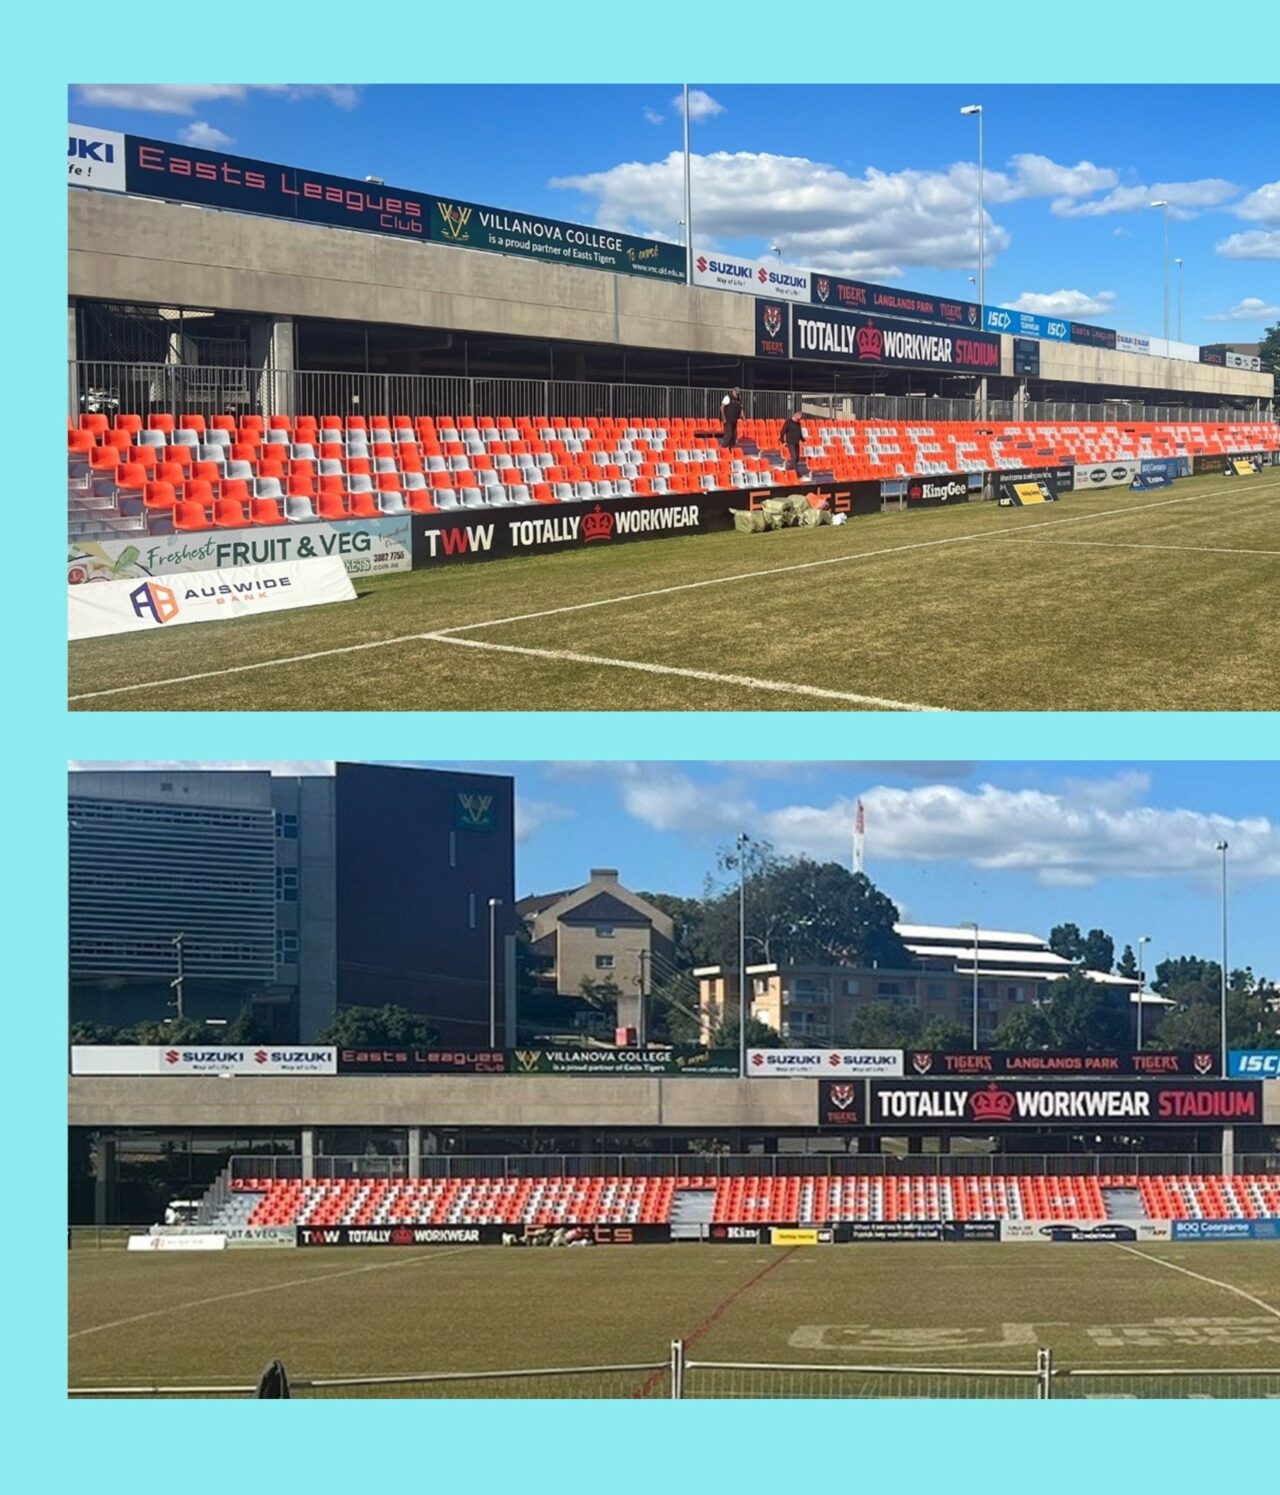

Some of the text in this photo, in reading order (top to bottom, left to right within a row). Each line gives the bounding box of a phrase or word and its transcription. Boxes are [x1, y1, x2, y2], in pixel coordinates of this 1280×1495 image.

[138, 145, 422, 218] Easts Leagues
[380, 214, 422, 233] Club
[479, 212, 562, 241] VILLANOVA
[566, 229, 622, 252] COLLEGE
[488, 234, 496, 244] is
[505, 237, 530, 251] proud
[532, 242, 562, 256] partner
[562, 246, 572, 258] of
[572, 248, 592, 261] Easts
[594, 252, 616, 265] Tigers
[709, 260, 752, 279] SUZUKI
[769, 272, 806, 289] SUZUKI
[837, 284, 866, 304] TIGERS
[874, 294, 934, 314] LANGLANDS PARK
[940, 303, 962, 322] TIGERS
[761, 340, 784, 354] TIGERS
[798, 320, 998, 366] TOTALLY WORKWEAR STADIUM
[922, 481, 966, 500] KingGee
[425, 524, 495, 558] TWW
[509, 515, 580, 547] TOTALLY
[615, 504, 699, 534] WORKWEAR
[146, 536, 216, 569] Freshest
[216, 538, 292, 567] FRUIT
[296, 536, 316, 558] &
[318, 530, 371, 556] VEG
[185, 576, 292, 600] AUSWIDE
[216, 592, 268, 605] BANK
[182, 1052, 244, 1062] SUZUKI
[271, 1052, 332, 1062] SUZUKI
[342, 1050, 504, 1065] Easts Leagues
[546, 1052, 671, 1062] VILLANOVA COLLEGE
[767, 1055, 821, 1064] SUZUKI
[843, 1055, 896, 1064] SUZUKI
[945, 1056, 992, 1070] TIGERS
[1006, 1058, 1118, 1068] LANGLANDS PARK
[1132, 1056, 1179, 1070] TIGERS
[476, 1062, 504, 1072] Club
[566, 1064, 586, 1072] proud
[644, 1064, 664, 1072] Tigers
[878, 1091, 1254, 1117] TOTALLY WORKWEAR STADIUM
[254, 1229, 278, 1238] VEG
[1177, 1223, 1249, 1232] BOQ Coorparoo
[302, 1230, 479, 1243] TWW TOTALLY WORKWEAR
